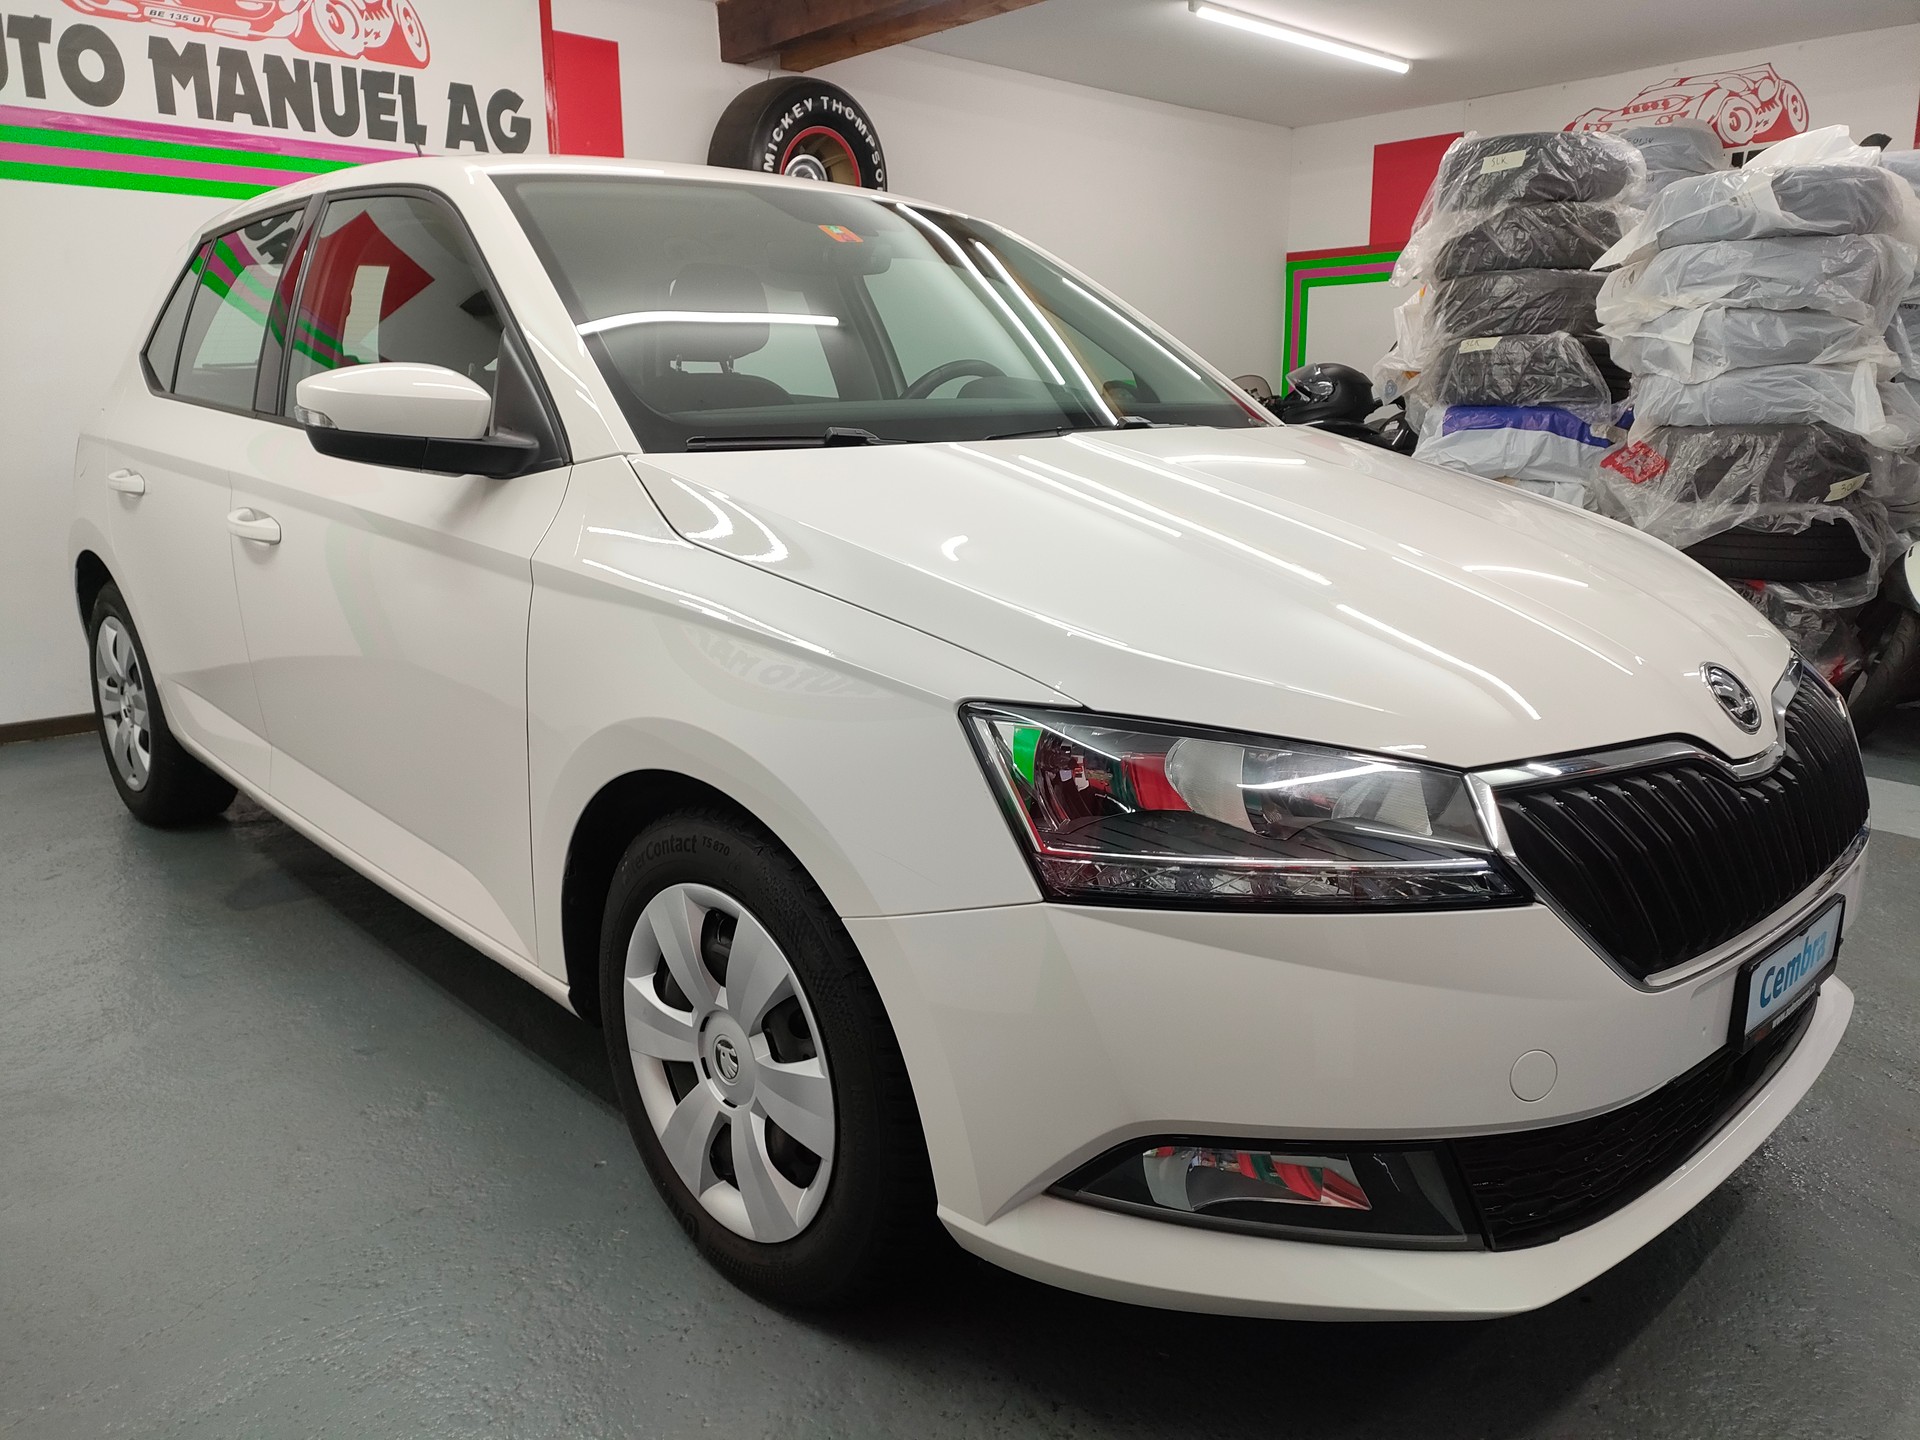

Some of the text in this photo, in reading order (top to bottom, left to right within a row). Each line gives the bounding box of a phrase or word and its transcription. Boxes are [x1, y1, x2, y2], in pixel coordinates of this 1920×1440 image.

[149, 9, 165, 18] BE
[169, 12, 189, 22] 135
[0, 12, 531, 154] TO MANUEL AG
[763, 95, 884, 193] MICKEY THOMPSO
[702, 835, 713, 849] TS
[712, 840, 731, 857] 870
[1759, 930, 1828, 1009] Cembra
